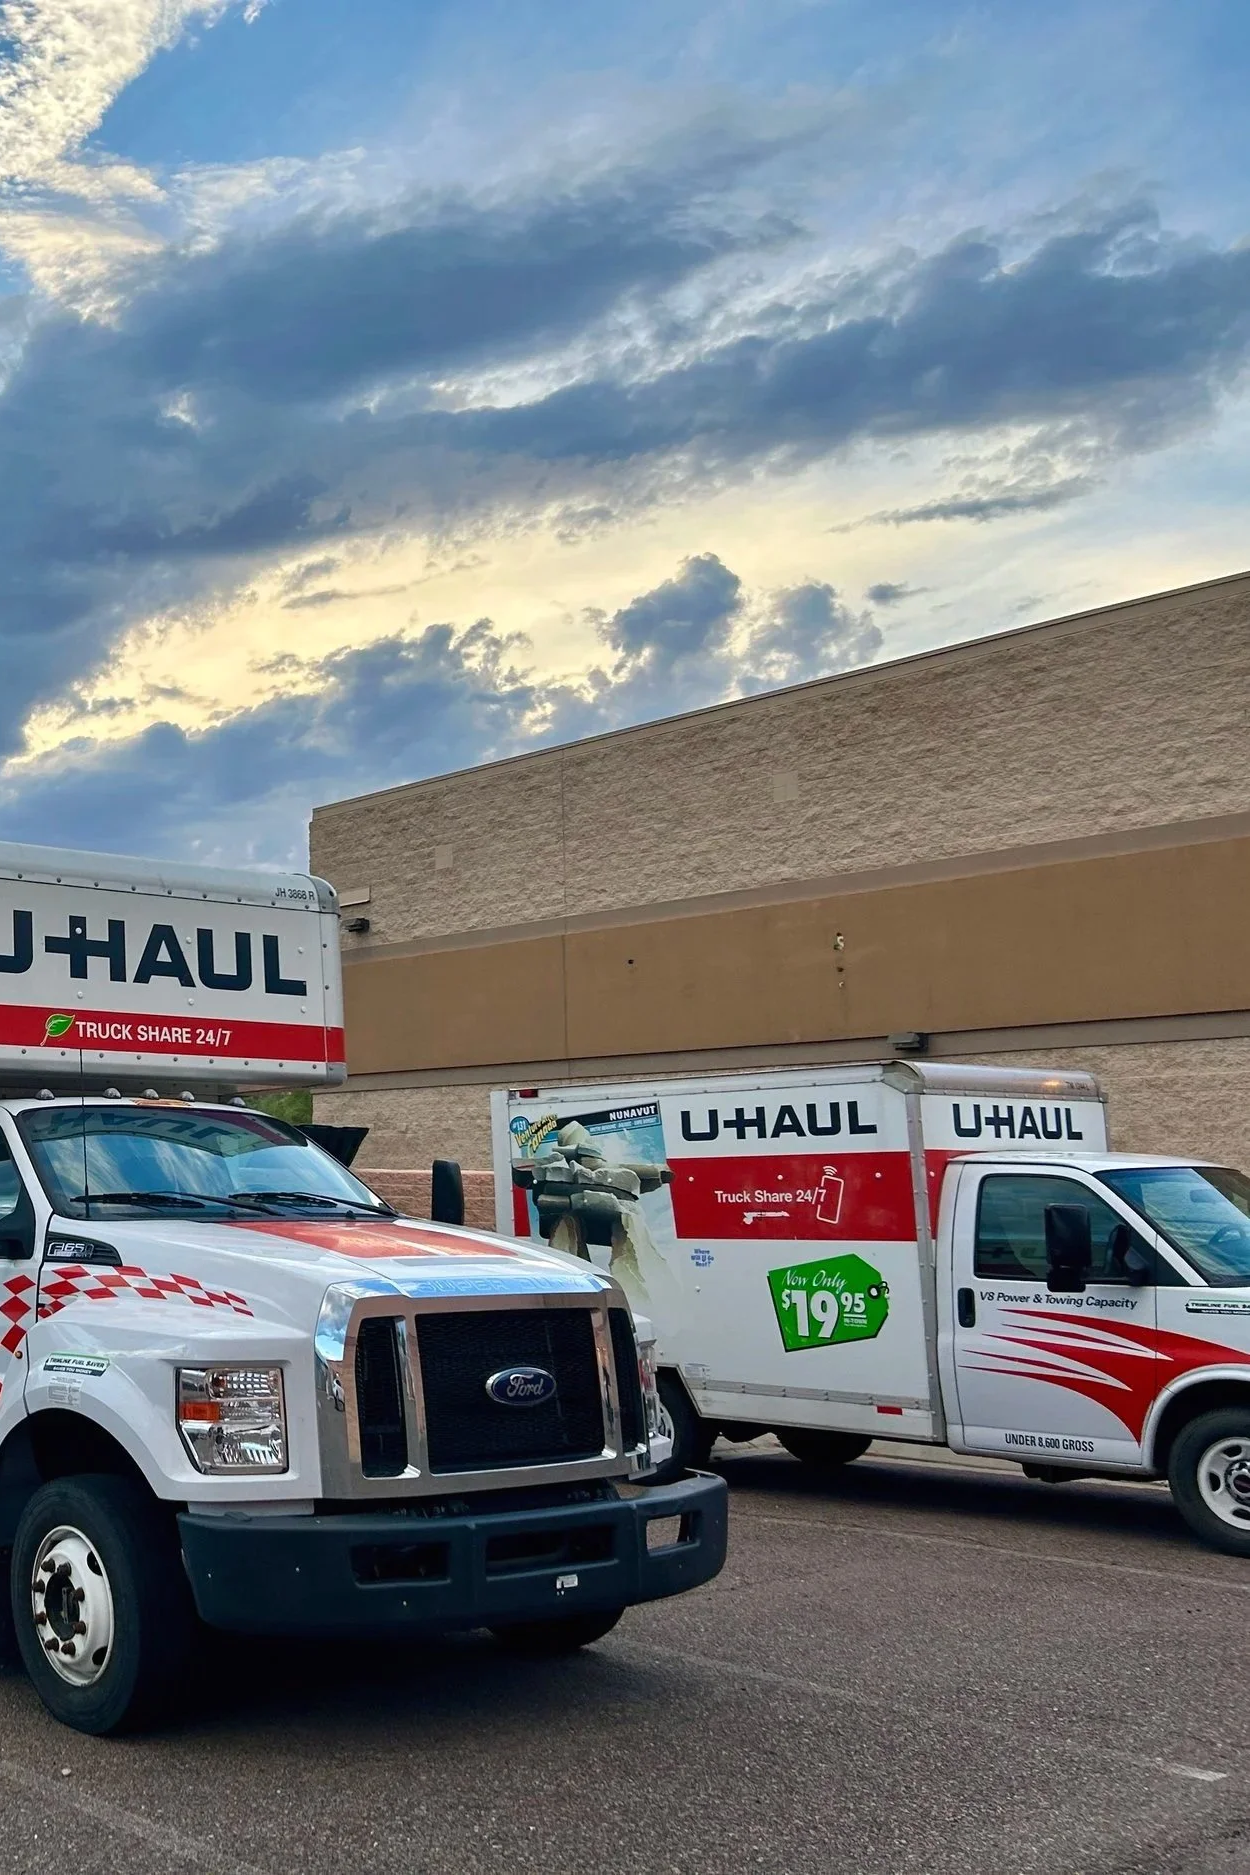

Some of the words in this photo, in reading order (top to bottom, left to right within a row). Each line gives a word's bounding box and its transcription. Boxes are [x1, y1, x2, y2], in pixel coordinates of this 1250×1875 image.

[275, 888, 286, 897] JH
[308, 891, 315, 900] R
[75, 1021, 133, 1041] TRUCK
[137, 1024, 192, 1044] SHARE
[196, 1028, 232, 1047] 24/7
[609, 1105, 655, 1121] NUNAVUT
[680, 1101, 877, 1142] U-HAUL
[952, 1103, 1083, 1140] U-HAUL
[714, 1190, 751, 1203] Truck
[754, 1190, 793, 1203] Share
[796, 1187, 827, 1205] 24/7
[782, 1270, 808, 1286] Now
[812, 1269, 848, 1295] Only
[980, 1291, 995, 1301] V8
[996, 1292, 1030, 1303] Power
[1033, 1293, 1043, 1304] &
[1045, 1295, 1083, 1308] Towing
[1085, 1296, 1138, 1310] Capacity
[506, 1373, 544, 1398] Ford
[1005, 1433, 1037, 1447] UNDER
[1038, 1436, 1060, 1449] 8,600
[1062, 1438, 1094, 1452] GROSS
